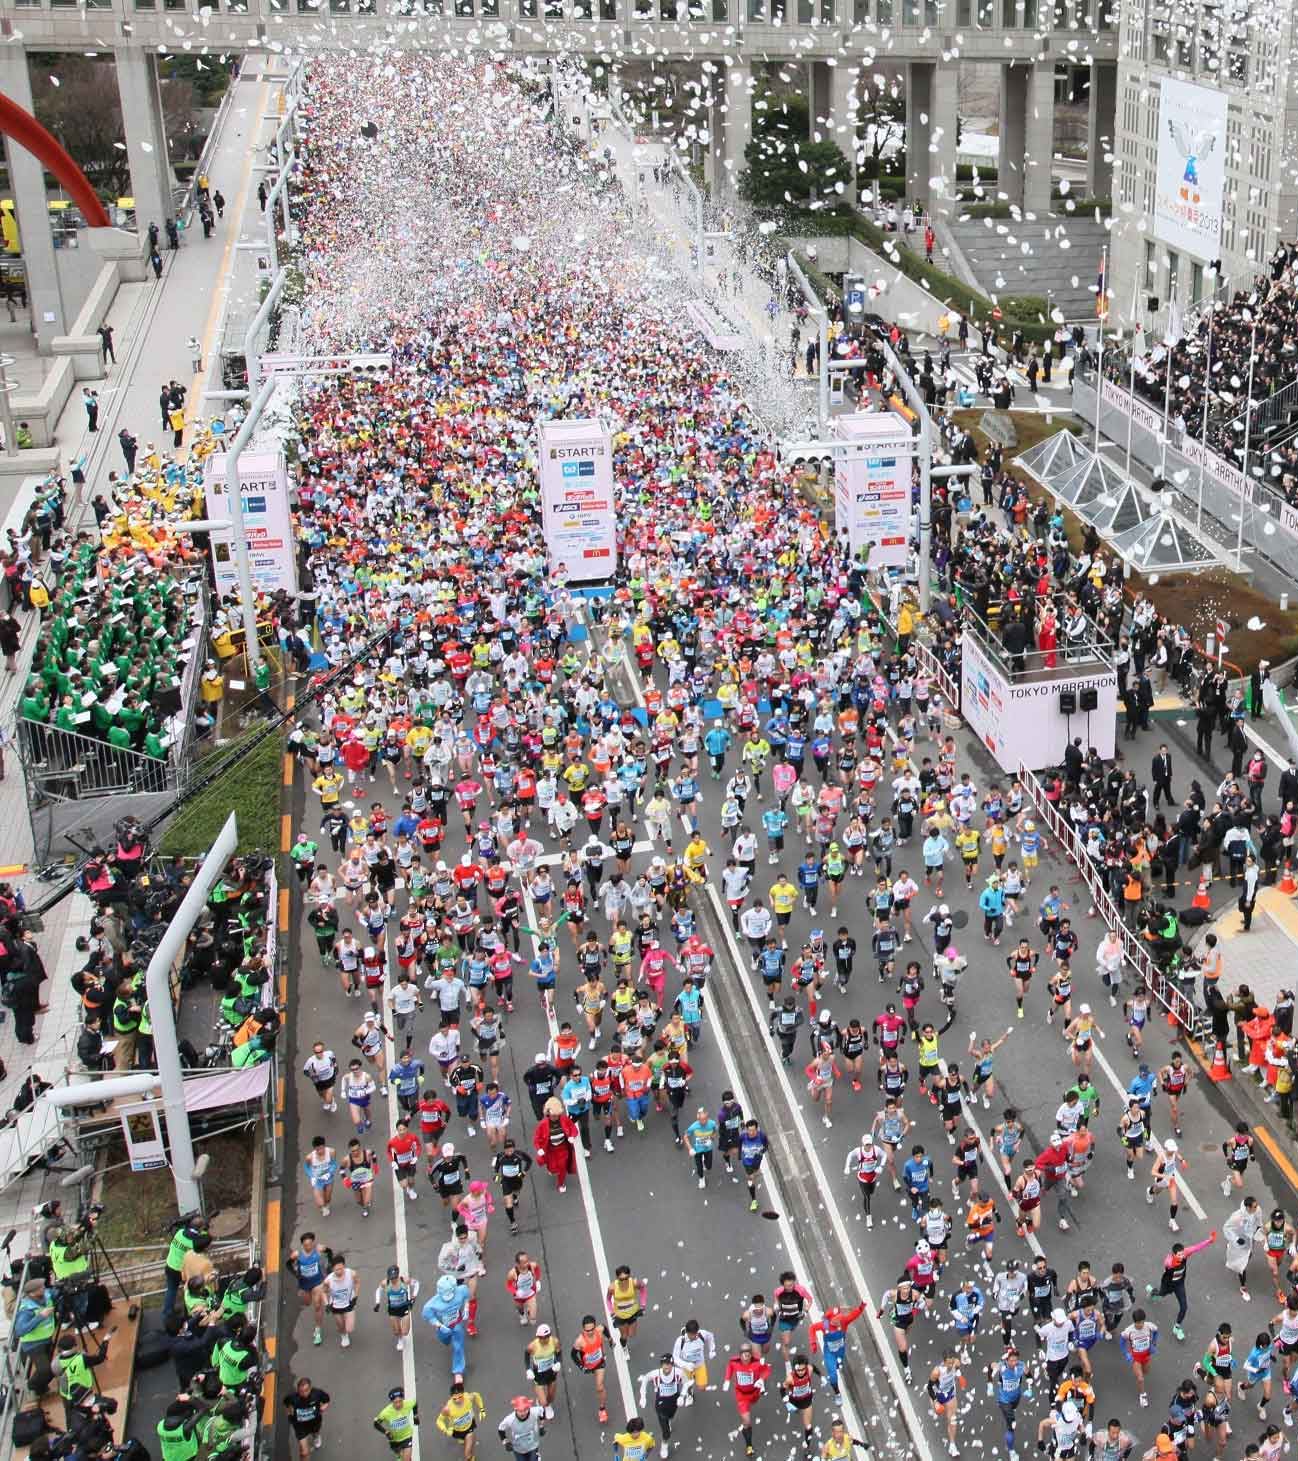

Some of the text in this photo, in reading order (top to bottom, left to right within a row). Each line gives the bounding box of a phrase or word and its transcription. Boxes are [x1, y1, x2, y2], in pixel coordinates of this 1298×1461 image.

[558, 447, 596, 458] START
[223, 481, 268, 494] SART
[1009, 677, 1116, 700] TOKYO MARATHON
